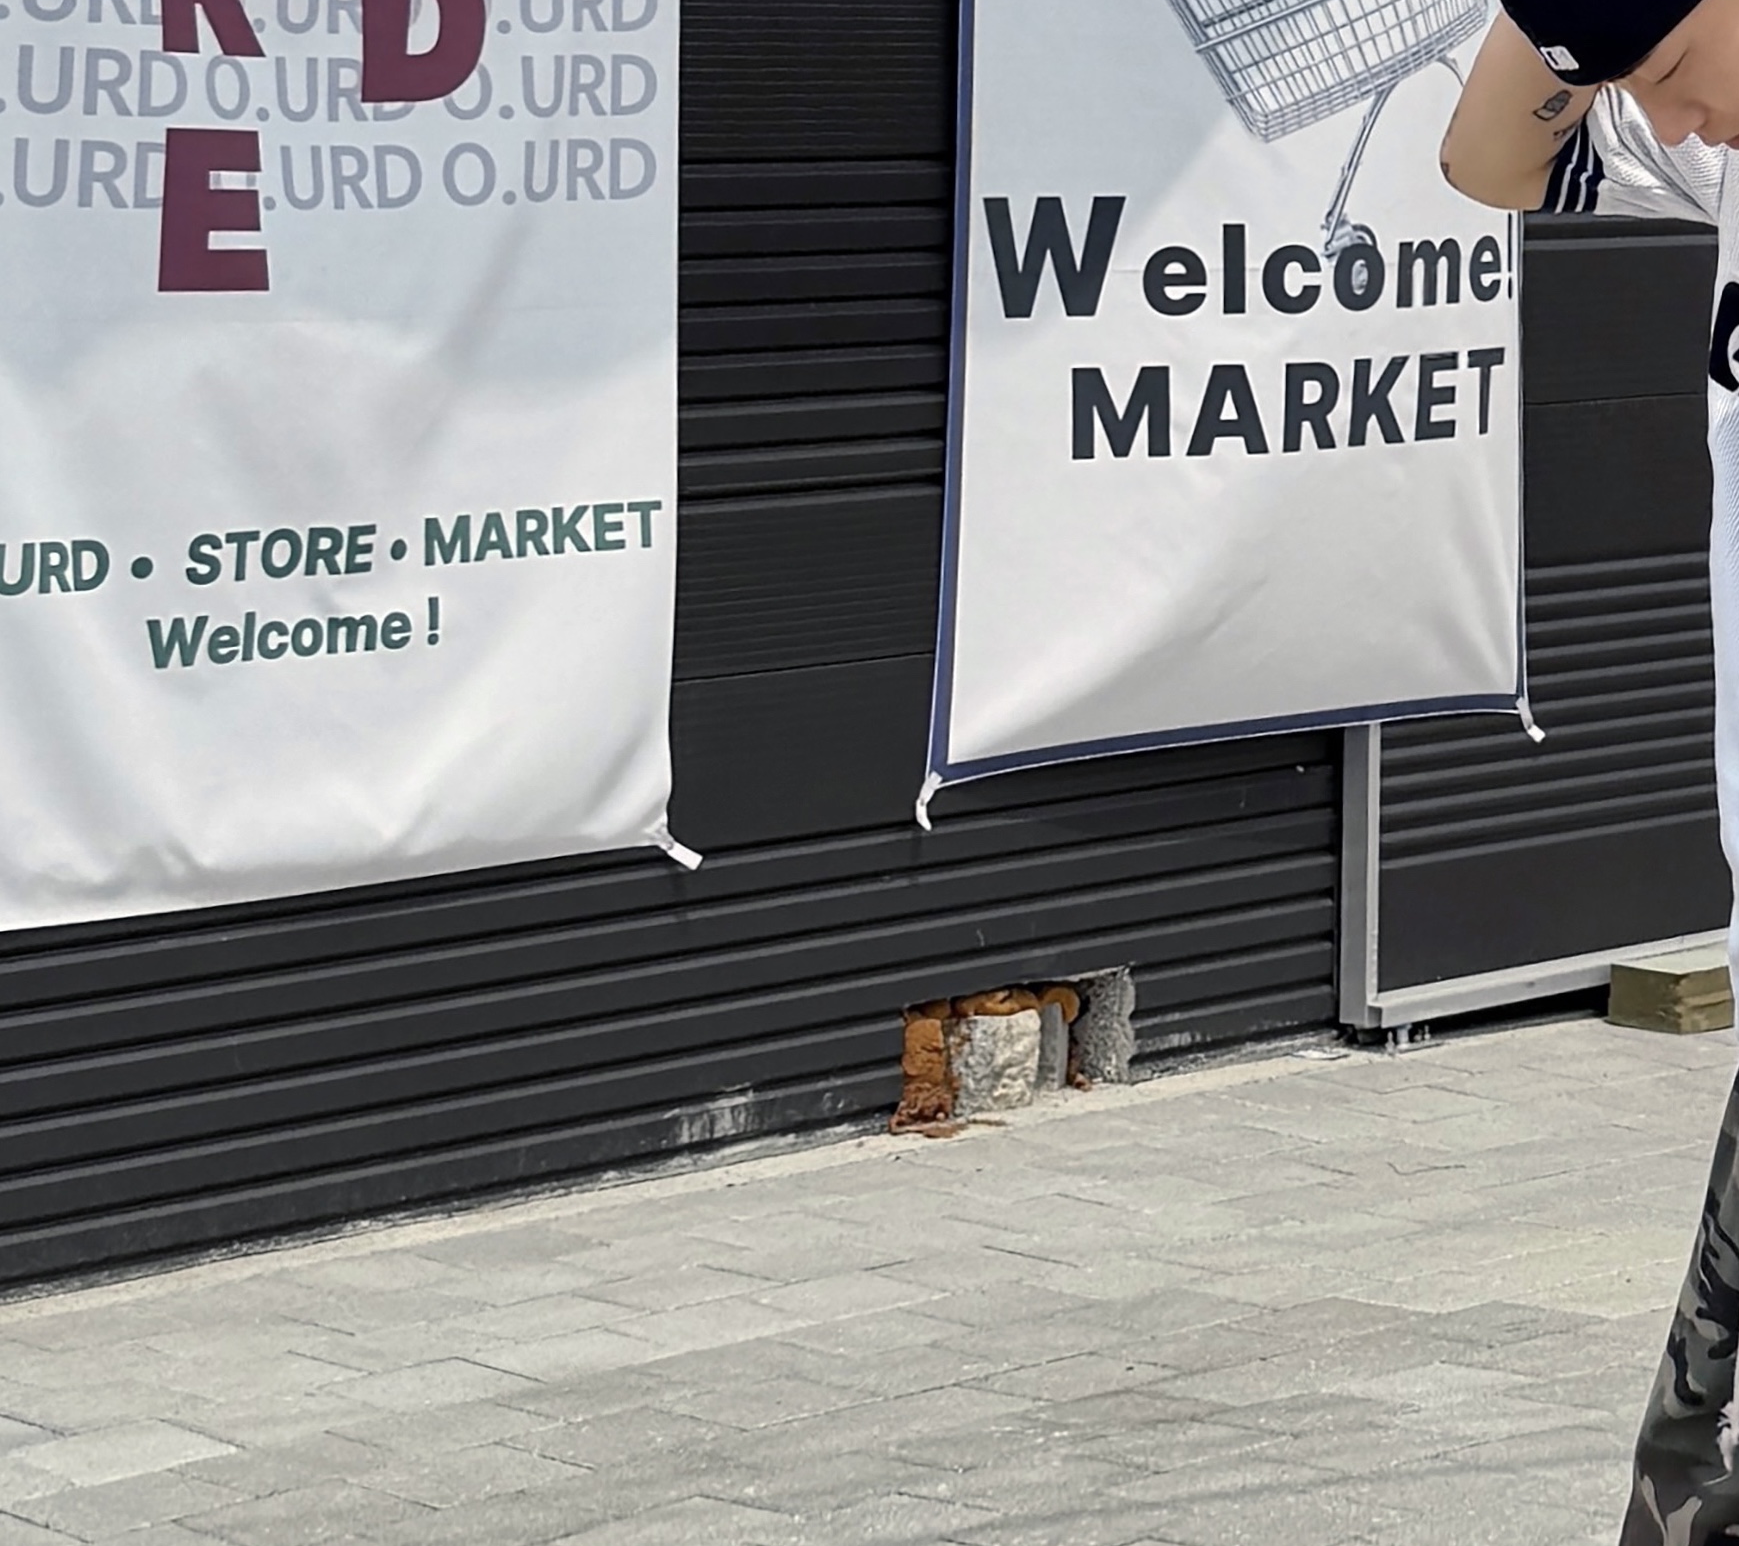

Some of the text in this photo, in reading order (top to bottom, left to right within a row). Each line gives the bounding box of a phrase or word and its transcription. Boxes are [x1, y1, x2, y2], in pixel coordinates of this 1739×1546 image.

[442, 137, 657, 207] O.URD
[981, 194, 1514, 319] Welcome!
[1070, 346, 1506, 461] MARKET
[185, 523, 377, 586] STORE
[423, 500, 663, 567] MARKET
[146, 611, 412, 669] Welcome
